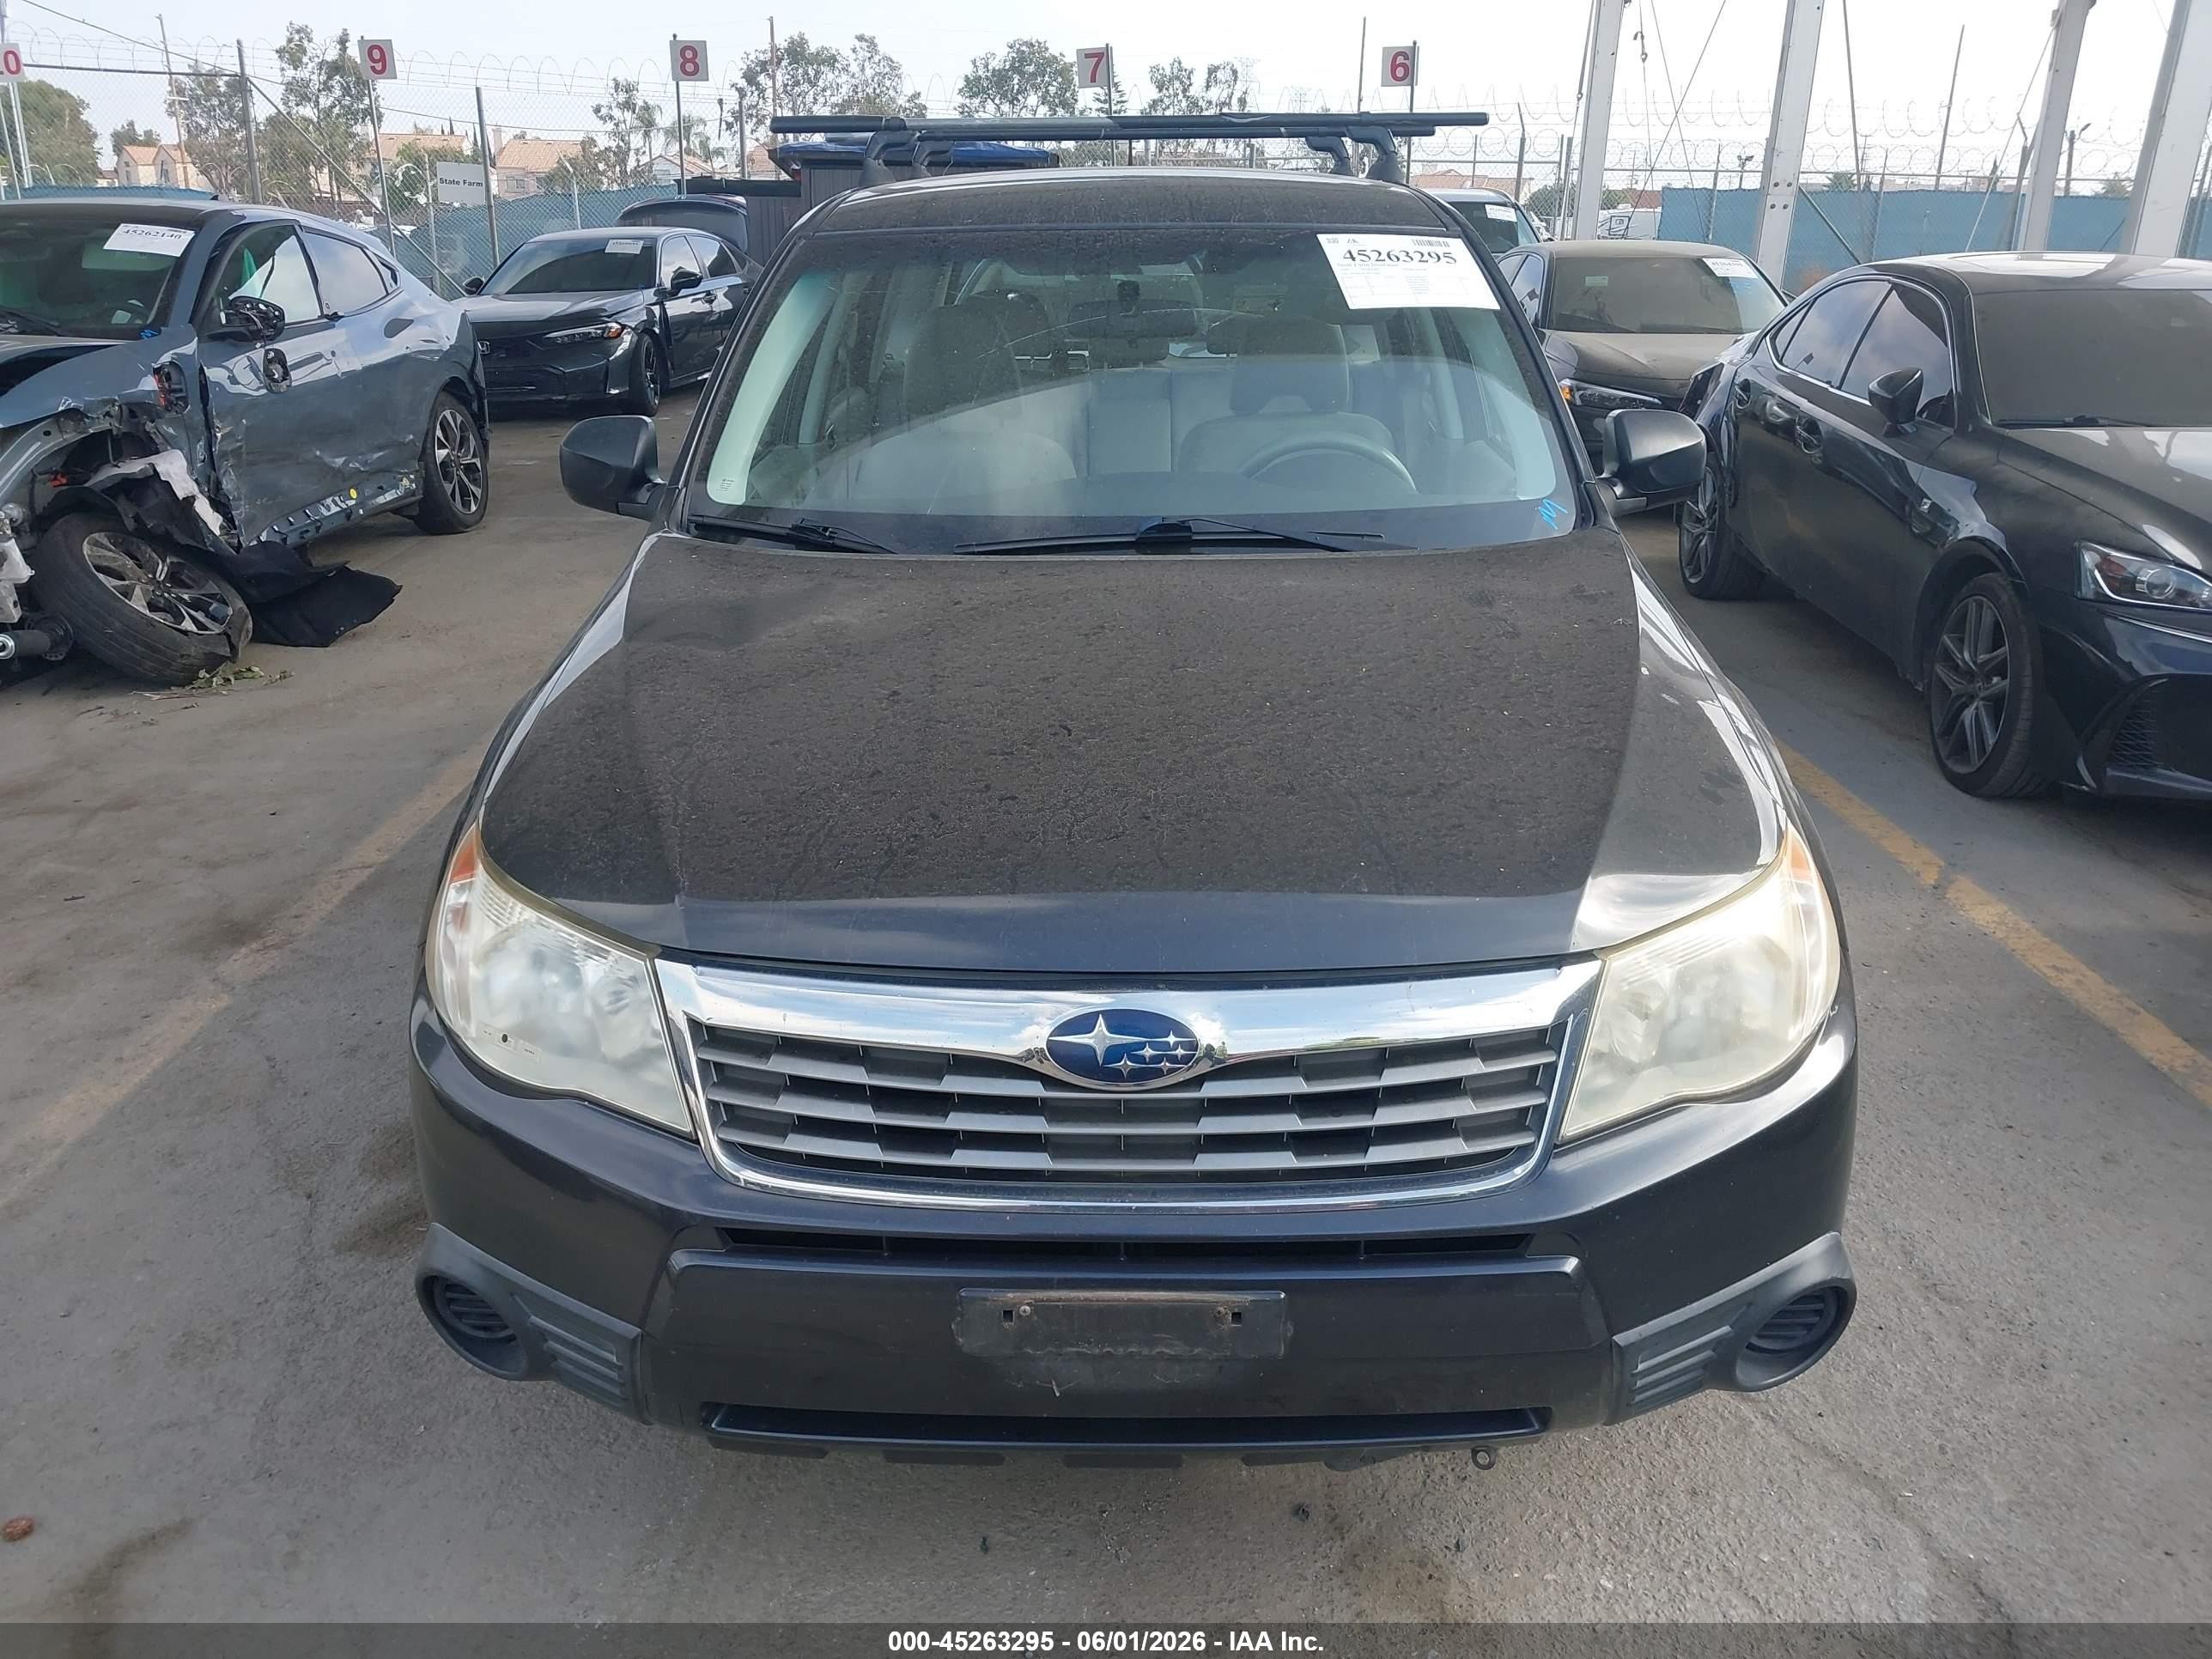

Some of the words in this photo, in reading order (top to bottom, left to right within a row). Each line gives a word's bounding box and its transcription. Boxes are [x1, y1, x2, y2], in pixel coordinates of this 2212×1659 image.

[368, 45, 386, 75] 9
[680, 46, 699, 76] 8
[1085, 52, 1104, 82] 7
[1390, 51, 1409, 82] 6
[439, 177, 460, 186] State
[462, 179, 483, 187] Farm
[122, 229, 182, 240] 45262140
[1343, 248, 1457, 264] 45263295
